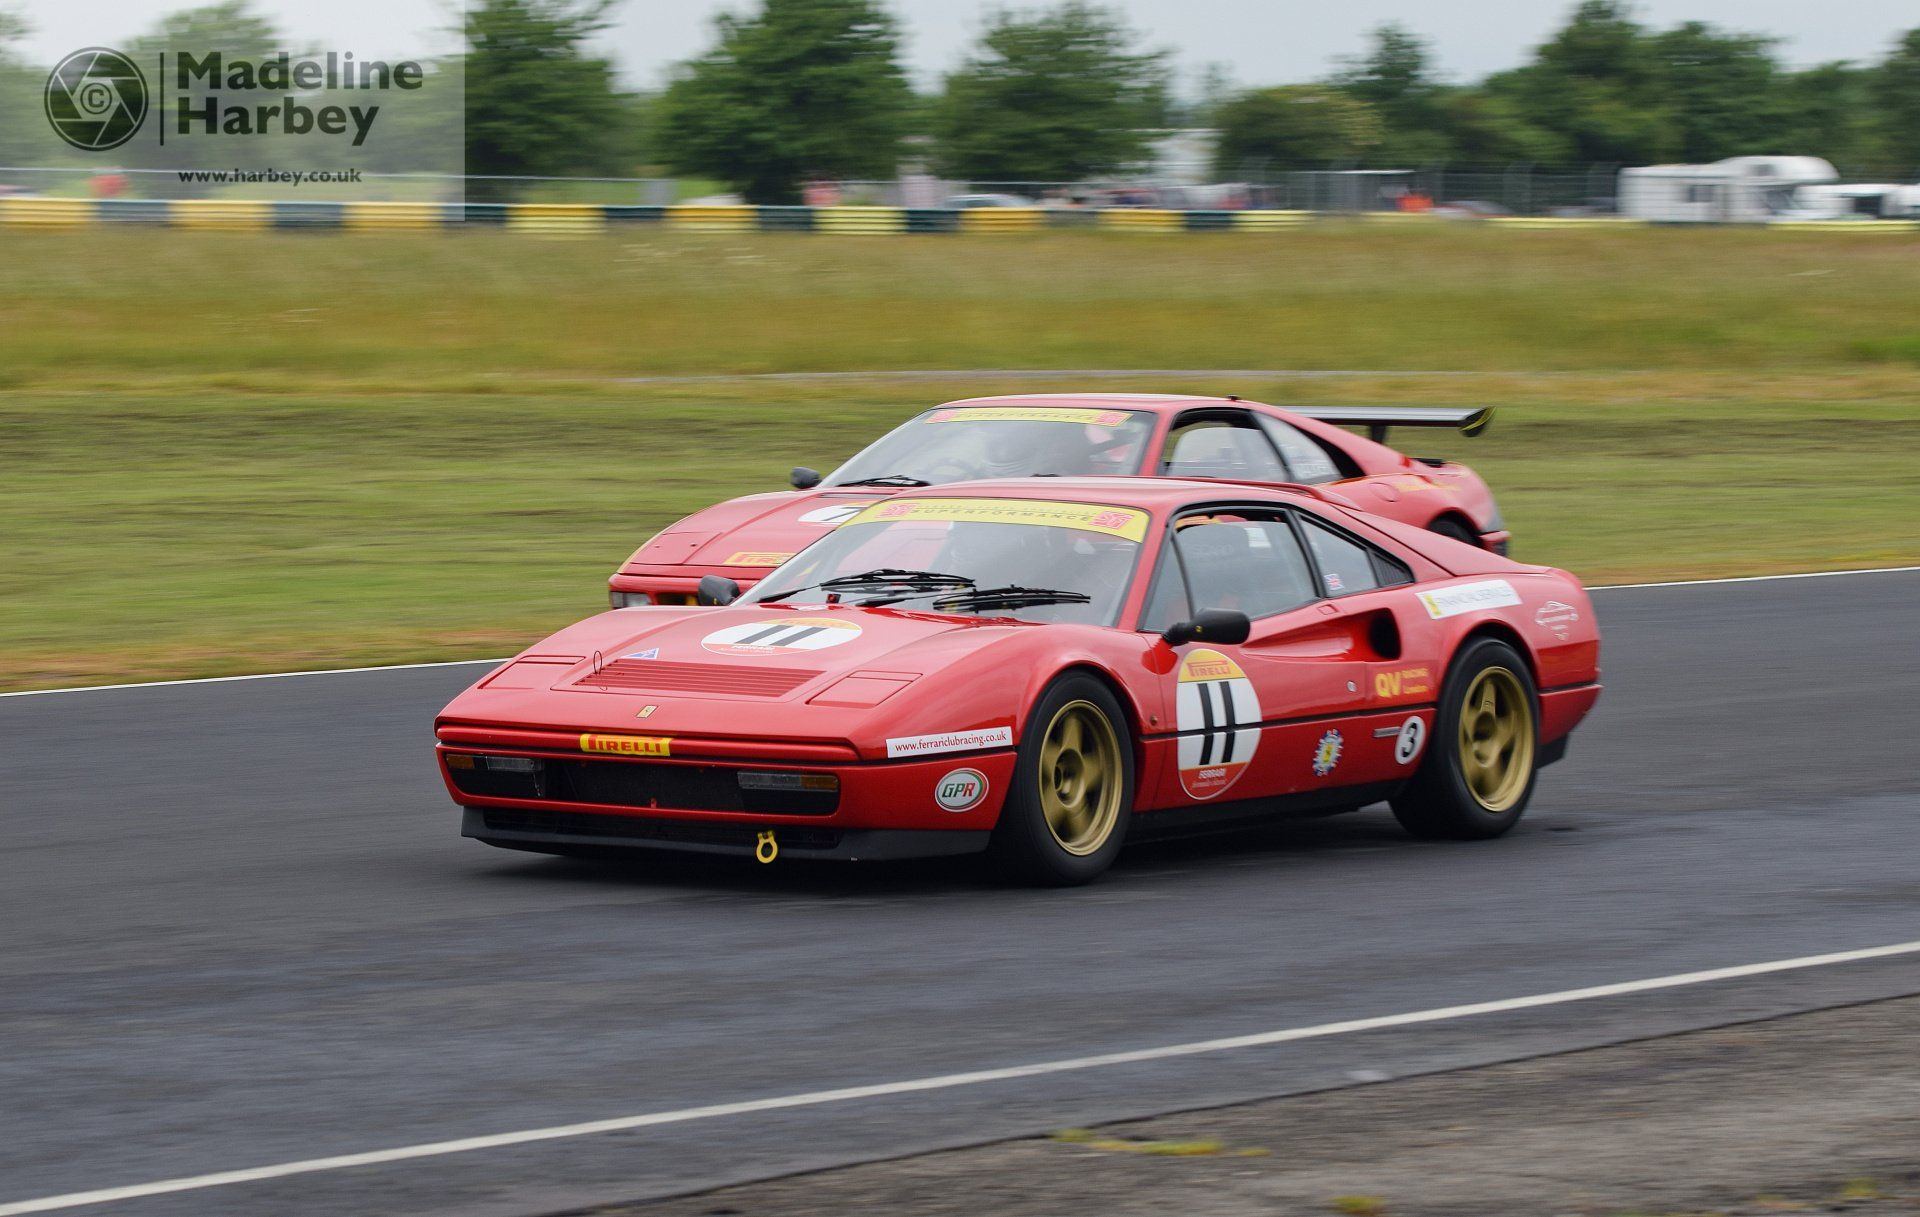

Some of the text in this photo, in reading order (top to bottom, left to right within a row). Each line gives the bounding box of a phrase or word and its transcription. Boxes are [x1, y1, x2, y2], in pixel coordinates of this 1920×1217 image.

[734, 624, 829, 646] 11
[1187, 660, 1231, 677] PIRELLI
[1197, 681, 1236, 765] 11
[587, 735, 662, 753] PIRELLI
[895, 730, 1007, 751] www.ferrariclubracing.co.uk
[1401, 722, 1418, 757] 3
[941, 782, 976, 798] GPR
